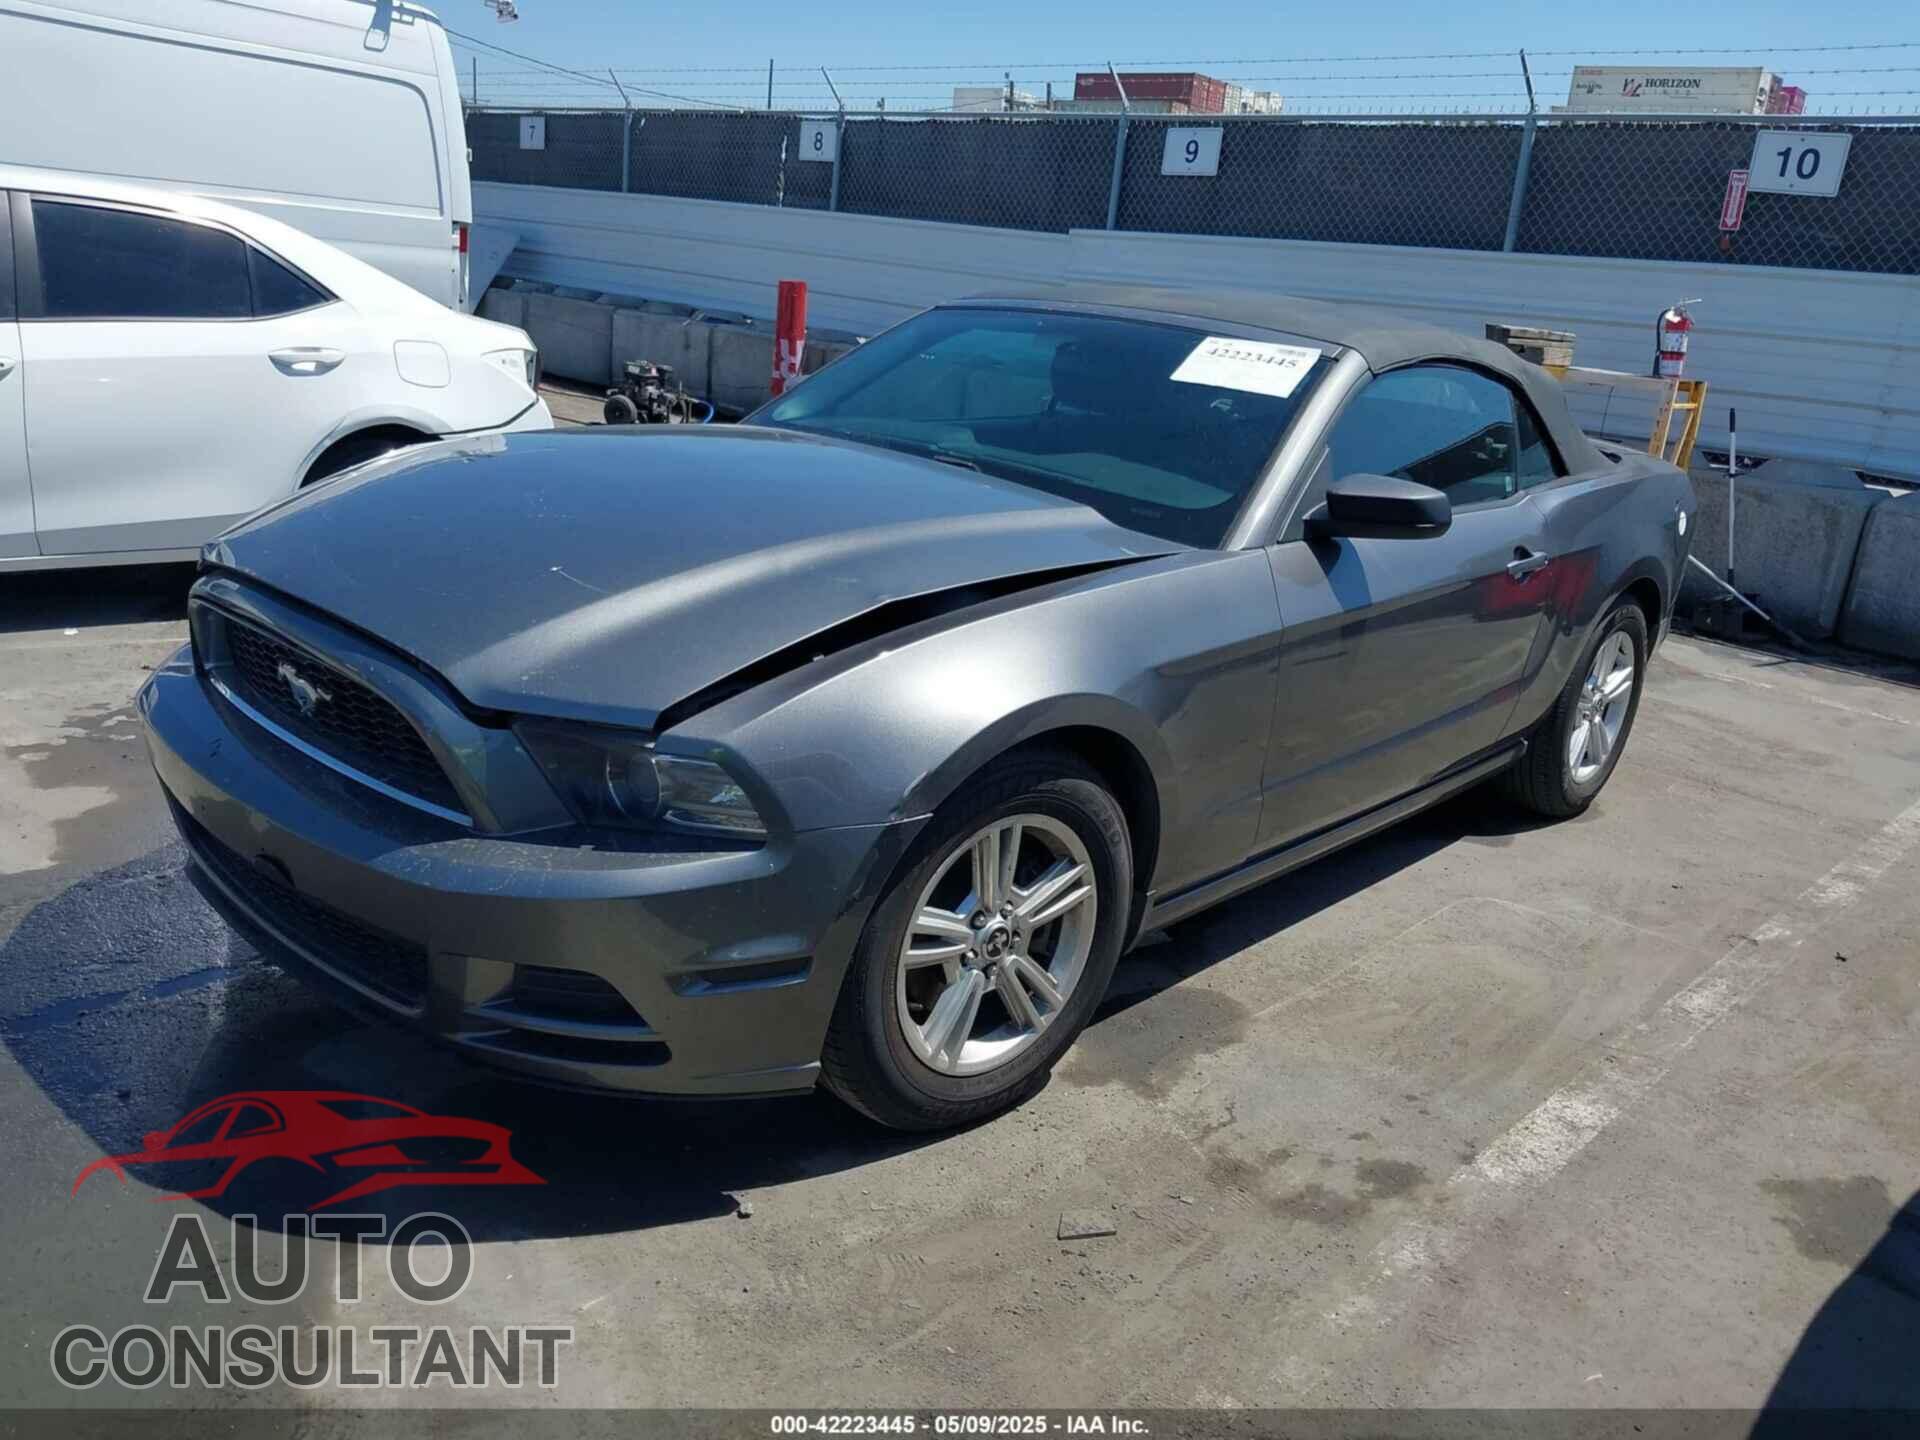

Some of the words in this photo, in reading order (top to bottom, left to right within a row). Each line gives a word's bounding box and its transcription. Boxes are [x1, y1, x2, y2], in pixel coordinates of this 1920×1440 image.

[1644, 78, 1702, 89] HORIZON
[528, 124, 536, 142] 7
[814, 131, 824, 152] 8
[1184, 139, 1200, 164] 9
[1776, 146, 1821, 180] 10
[1206, 347, 1298, 369] 42223445
